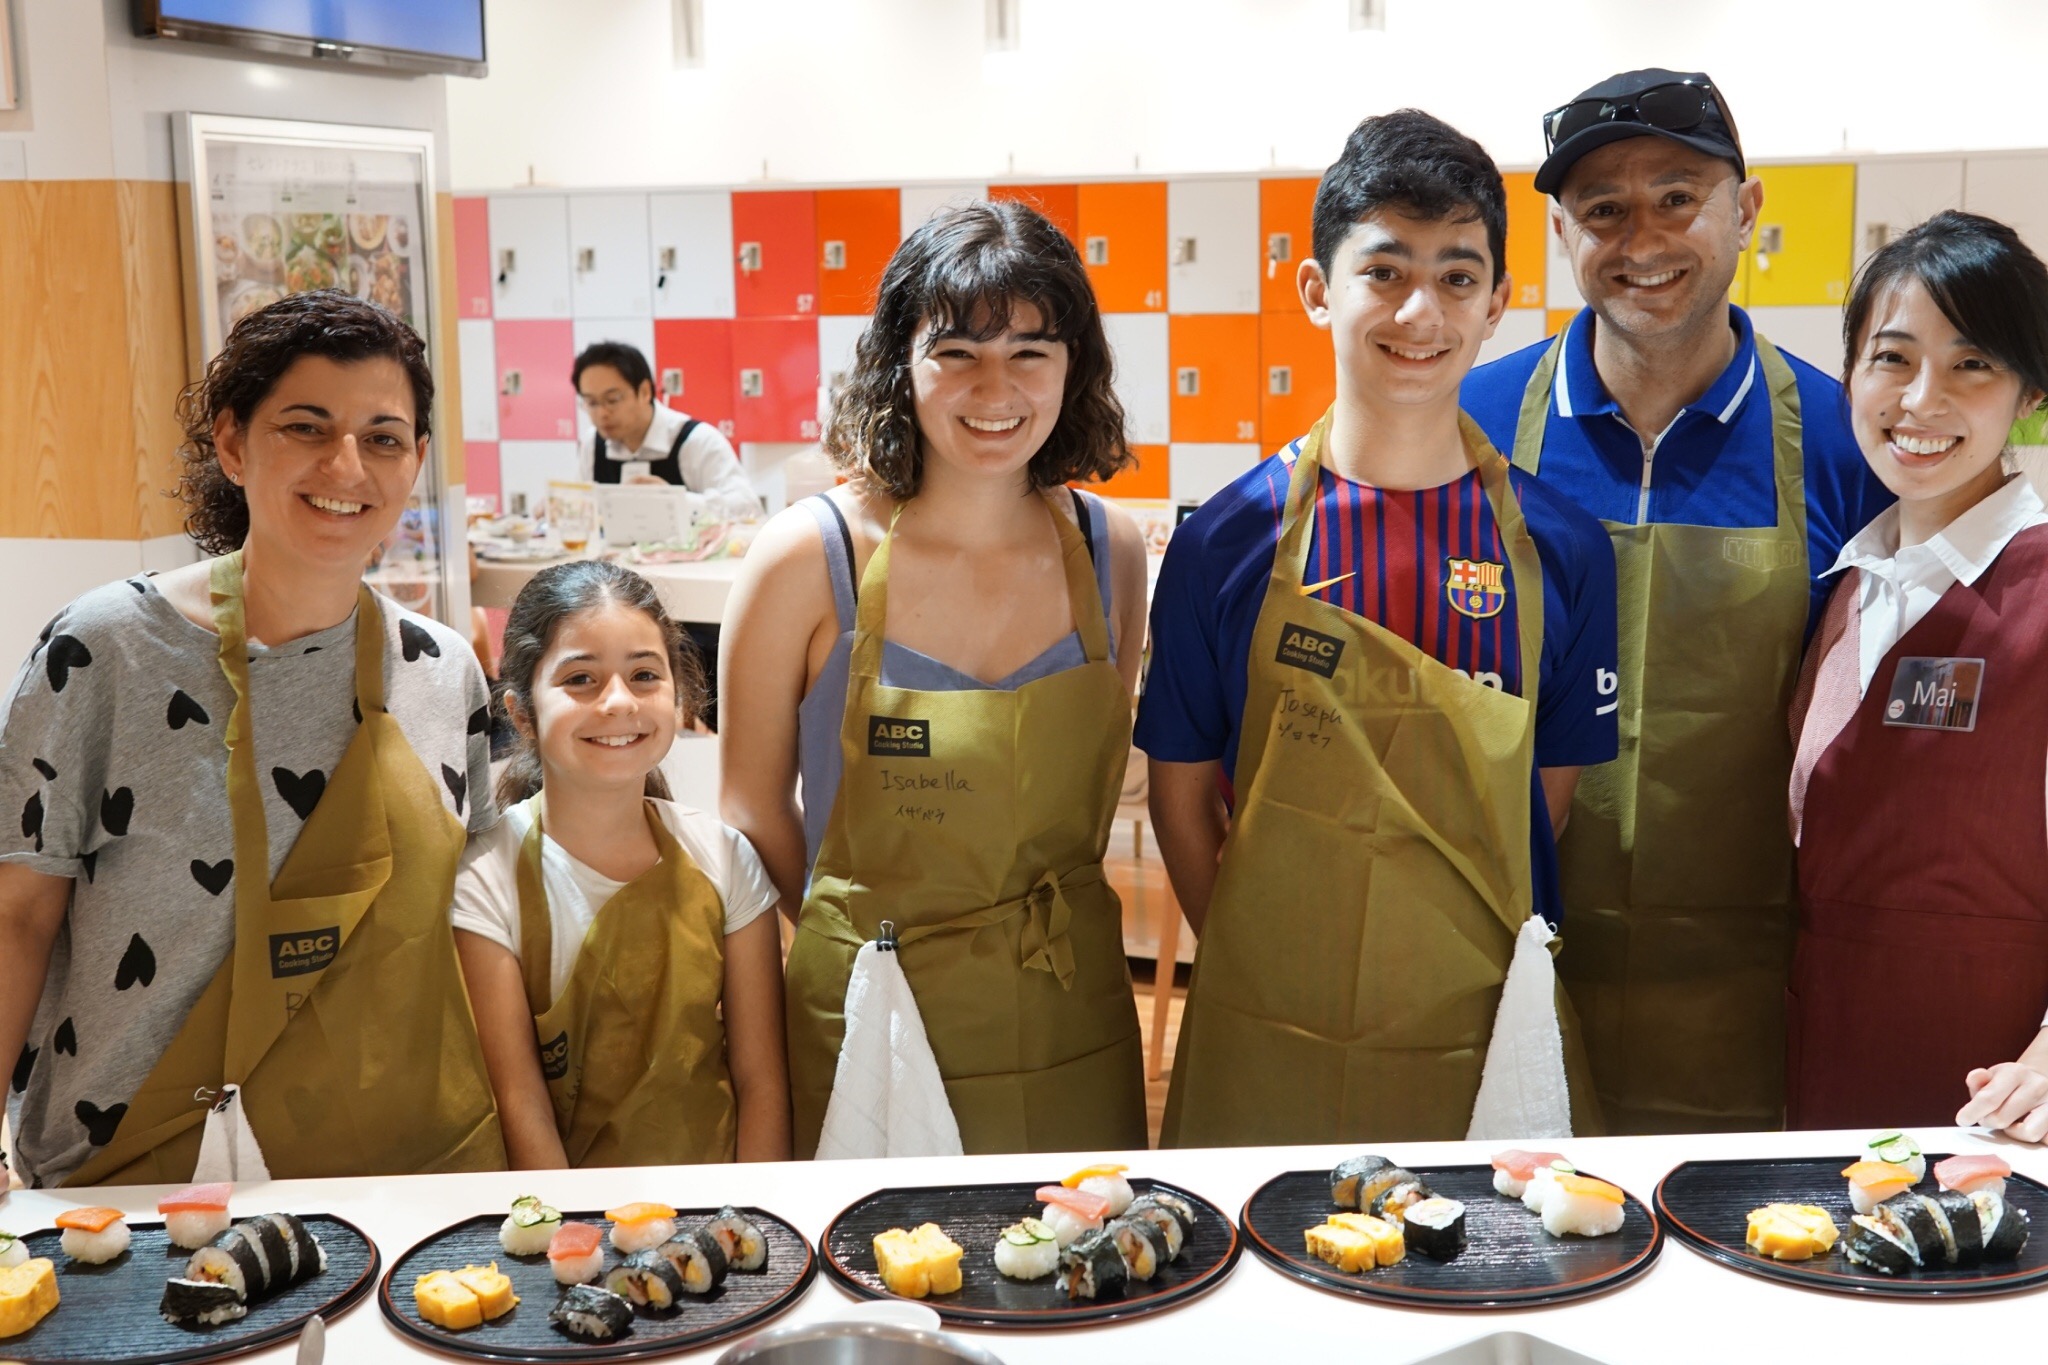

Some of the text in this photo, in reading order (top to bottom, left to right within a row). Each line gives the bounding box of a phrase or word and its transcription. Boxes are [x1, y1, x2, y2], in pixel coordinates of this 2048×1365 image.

[797, 294, 813, 312] 57
[1144, 290, 1161, 307] 41
[1465, 583, 1487, 592] FCB
[1285, 632, 1336, 657] ABC
[1282, 647, 1330, 669] Cooking Studio
[1912, 681, 1957, 708] Mai
[1280, 689, 1343, 731] Joseph
[874, 723, 924, 740] ABC
[874, 740, 924, 750] Cooking Studio
[881, 769, 976, 792] Isabella
[278, 935, 334, 957] ABC
[278, 952, 334, 969] Cooking Studio
[541, 1041, 567, 1064] BC
